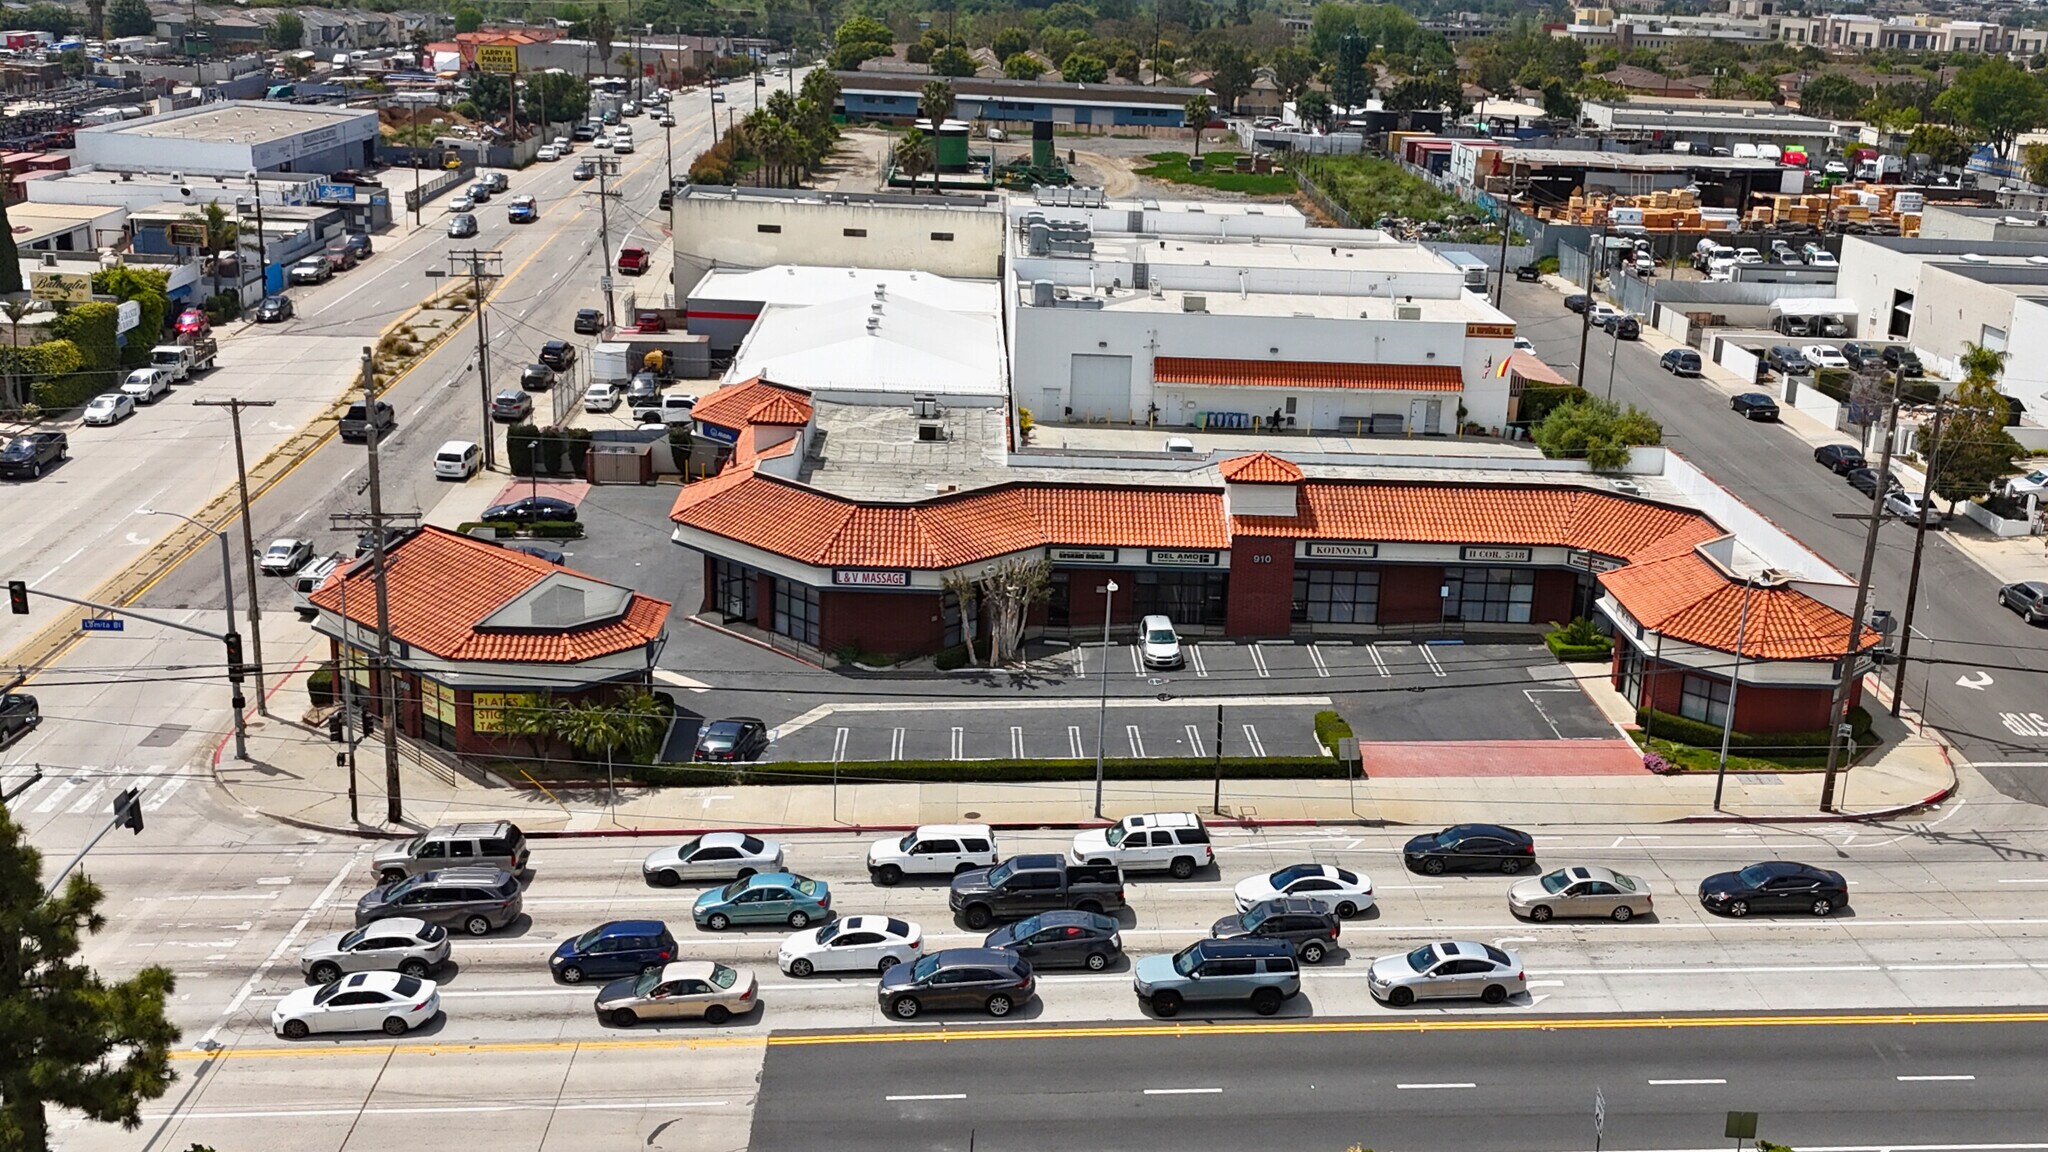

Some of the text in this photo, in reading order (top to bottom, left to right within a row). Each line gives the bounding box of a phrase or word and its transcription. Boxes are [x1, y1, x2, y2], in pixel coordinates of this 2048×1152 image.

[1316, 546, 1368, 555] KOINONIA
[1479, 550, 1502, 559] COR.
[1504, 551, 1525, 559] 5:18
[1253, 555, 1272, 563] 910
[837, 572, 904, 584] L & V MASSAGE
